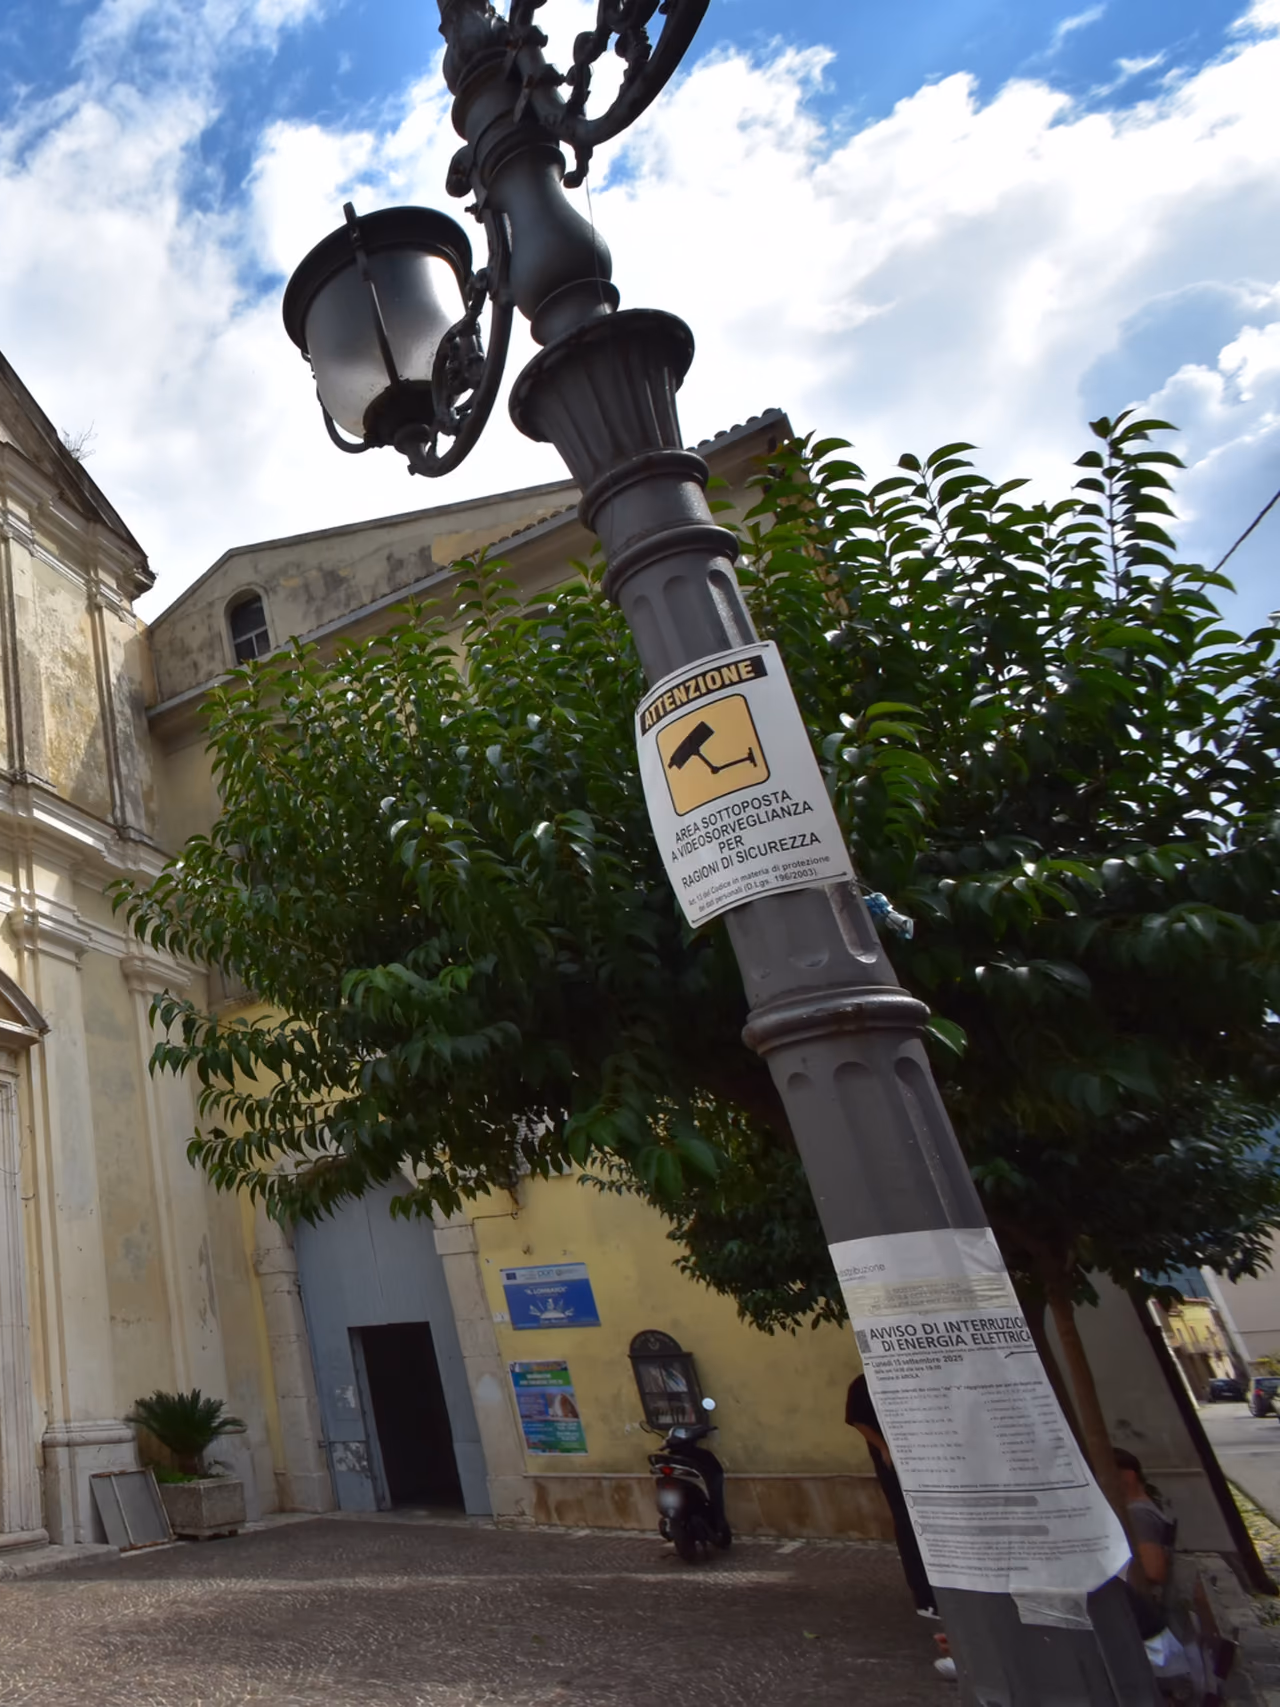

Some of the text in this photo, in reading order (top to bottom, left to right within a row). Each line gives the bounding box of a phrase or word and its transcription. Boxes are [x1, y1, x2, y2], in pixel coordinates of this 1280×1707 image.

[644, 660, 756, 730] ATTENZIONE
[675, 789, 793, 844] AREA SOTTOPOSTA
[671, 800, 814, 863] A VIDEOSORVEGLIANZA
[718, 834, 745, 855] PER
[681, 831, 821, 889] RAGIONI DI SICUREZZA
[732, 876, 739, 884] in
[740, 868, 770, 883] materia
[771, 863, 780, 874] di
[782, 855, 831, 873] protezione
[774, 867, 818, 884] 196/2003)
[869, 1323, 917, 1341] AVVISO
[922, 1322, 940, 1335] DI
[882, 1340, 896, 1353] DI
[897, 1334, 968, 1351] ENERGIA
[902, 1356, 941, 1366] settembre
